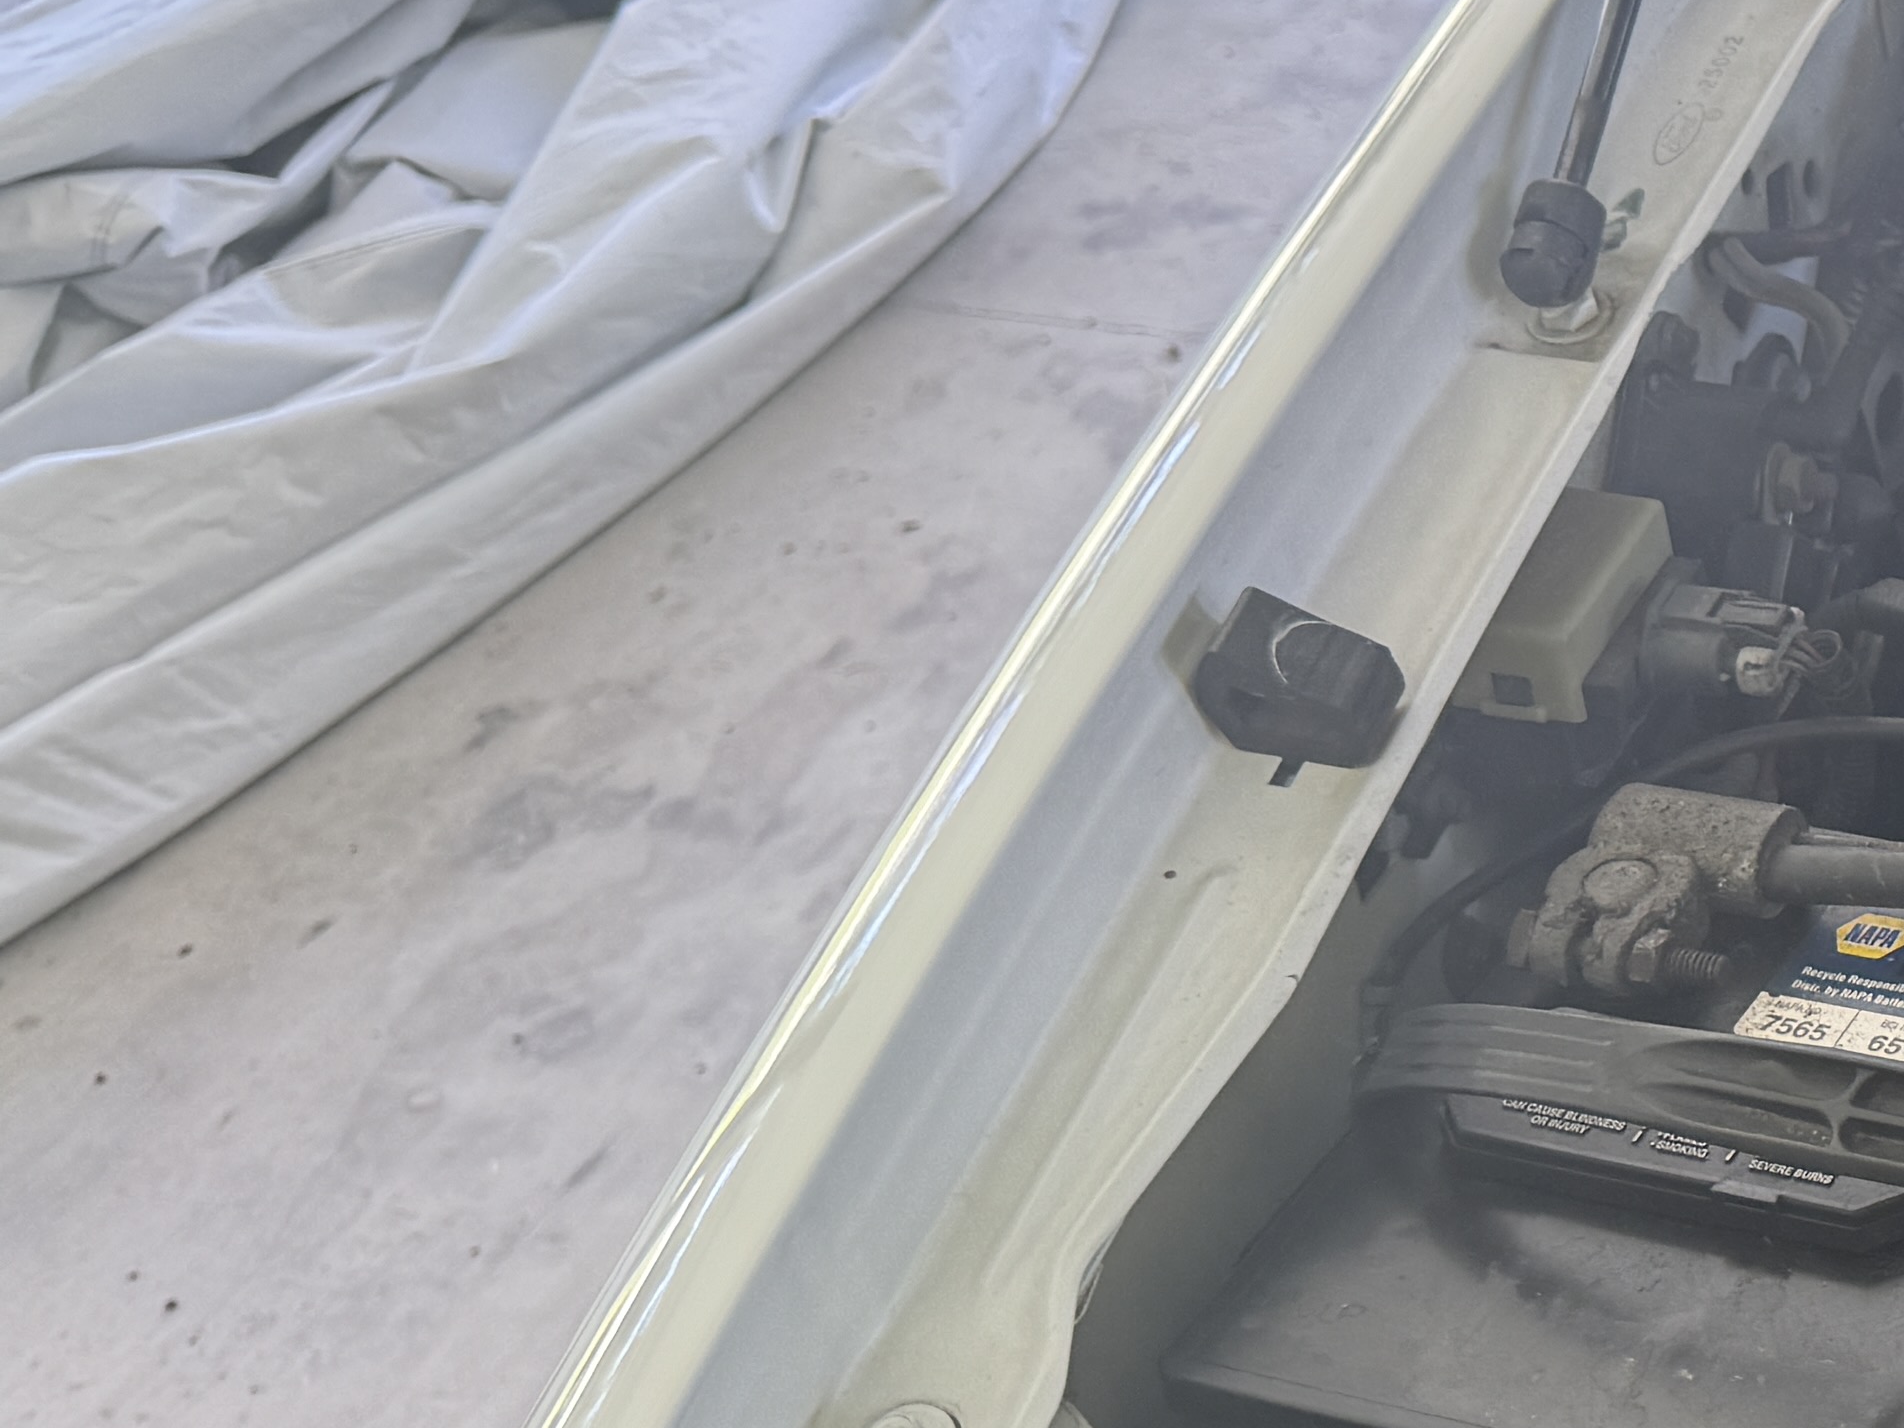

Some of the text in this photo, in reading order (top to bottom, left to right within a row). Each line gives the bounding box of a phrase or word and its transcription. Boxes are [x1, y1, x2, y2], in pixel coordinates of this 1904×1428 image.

[1845, 923, 1902, 949] NAPA
[1802, 966, 1846, 984] Recycle
[1824, 985, 1839, 1001] by
[1841, 988, 1873, 1002] NAPA
[1758, 1014, 1831, 1041] 7565
[1527, 1103, 1563, 1118] CAUSE
[1564, 1110, 1627, 1131] BLINDNESS
[1531, 1115, 1591, 1135] OR INJURY
[1748, 1159, 1834, 1186] SEVERE BURNS
